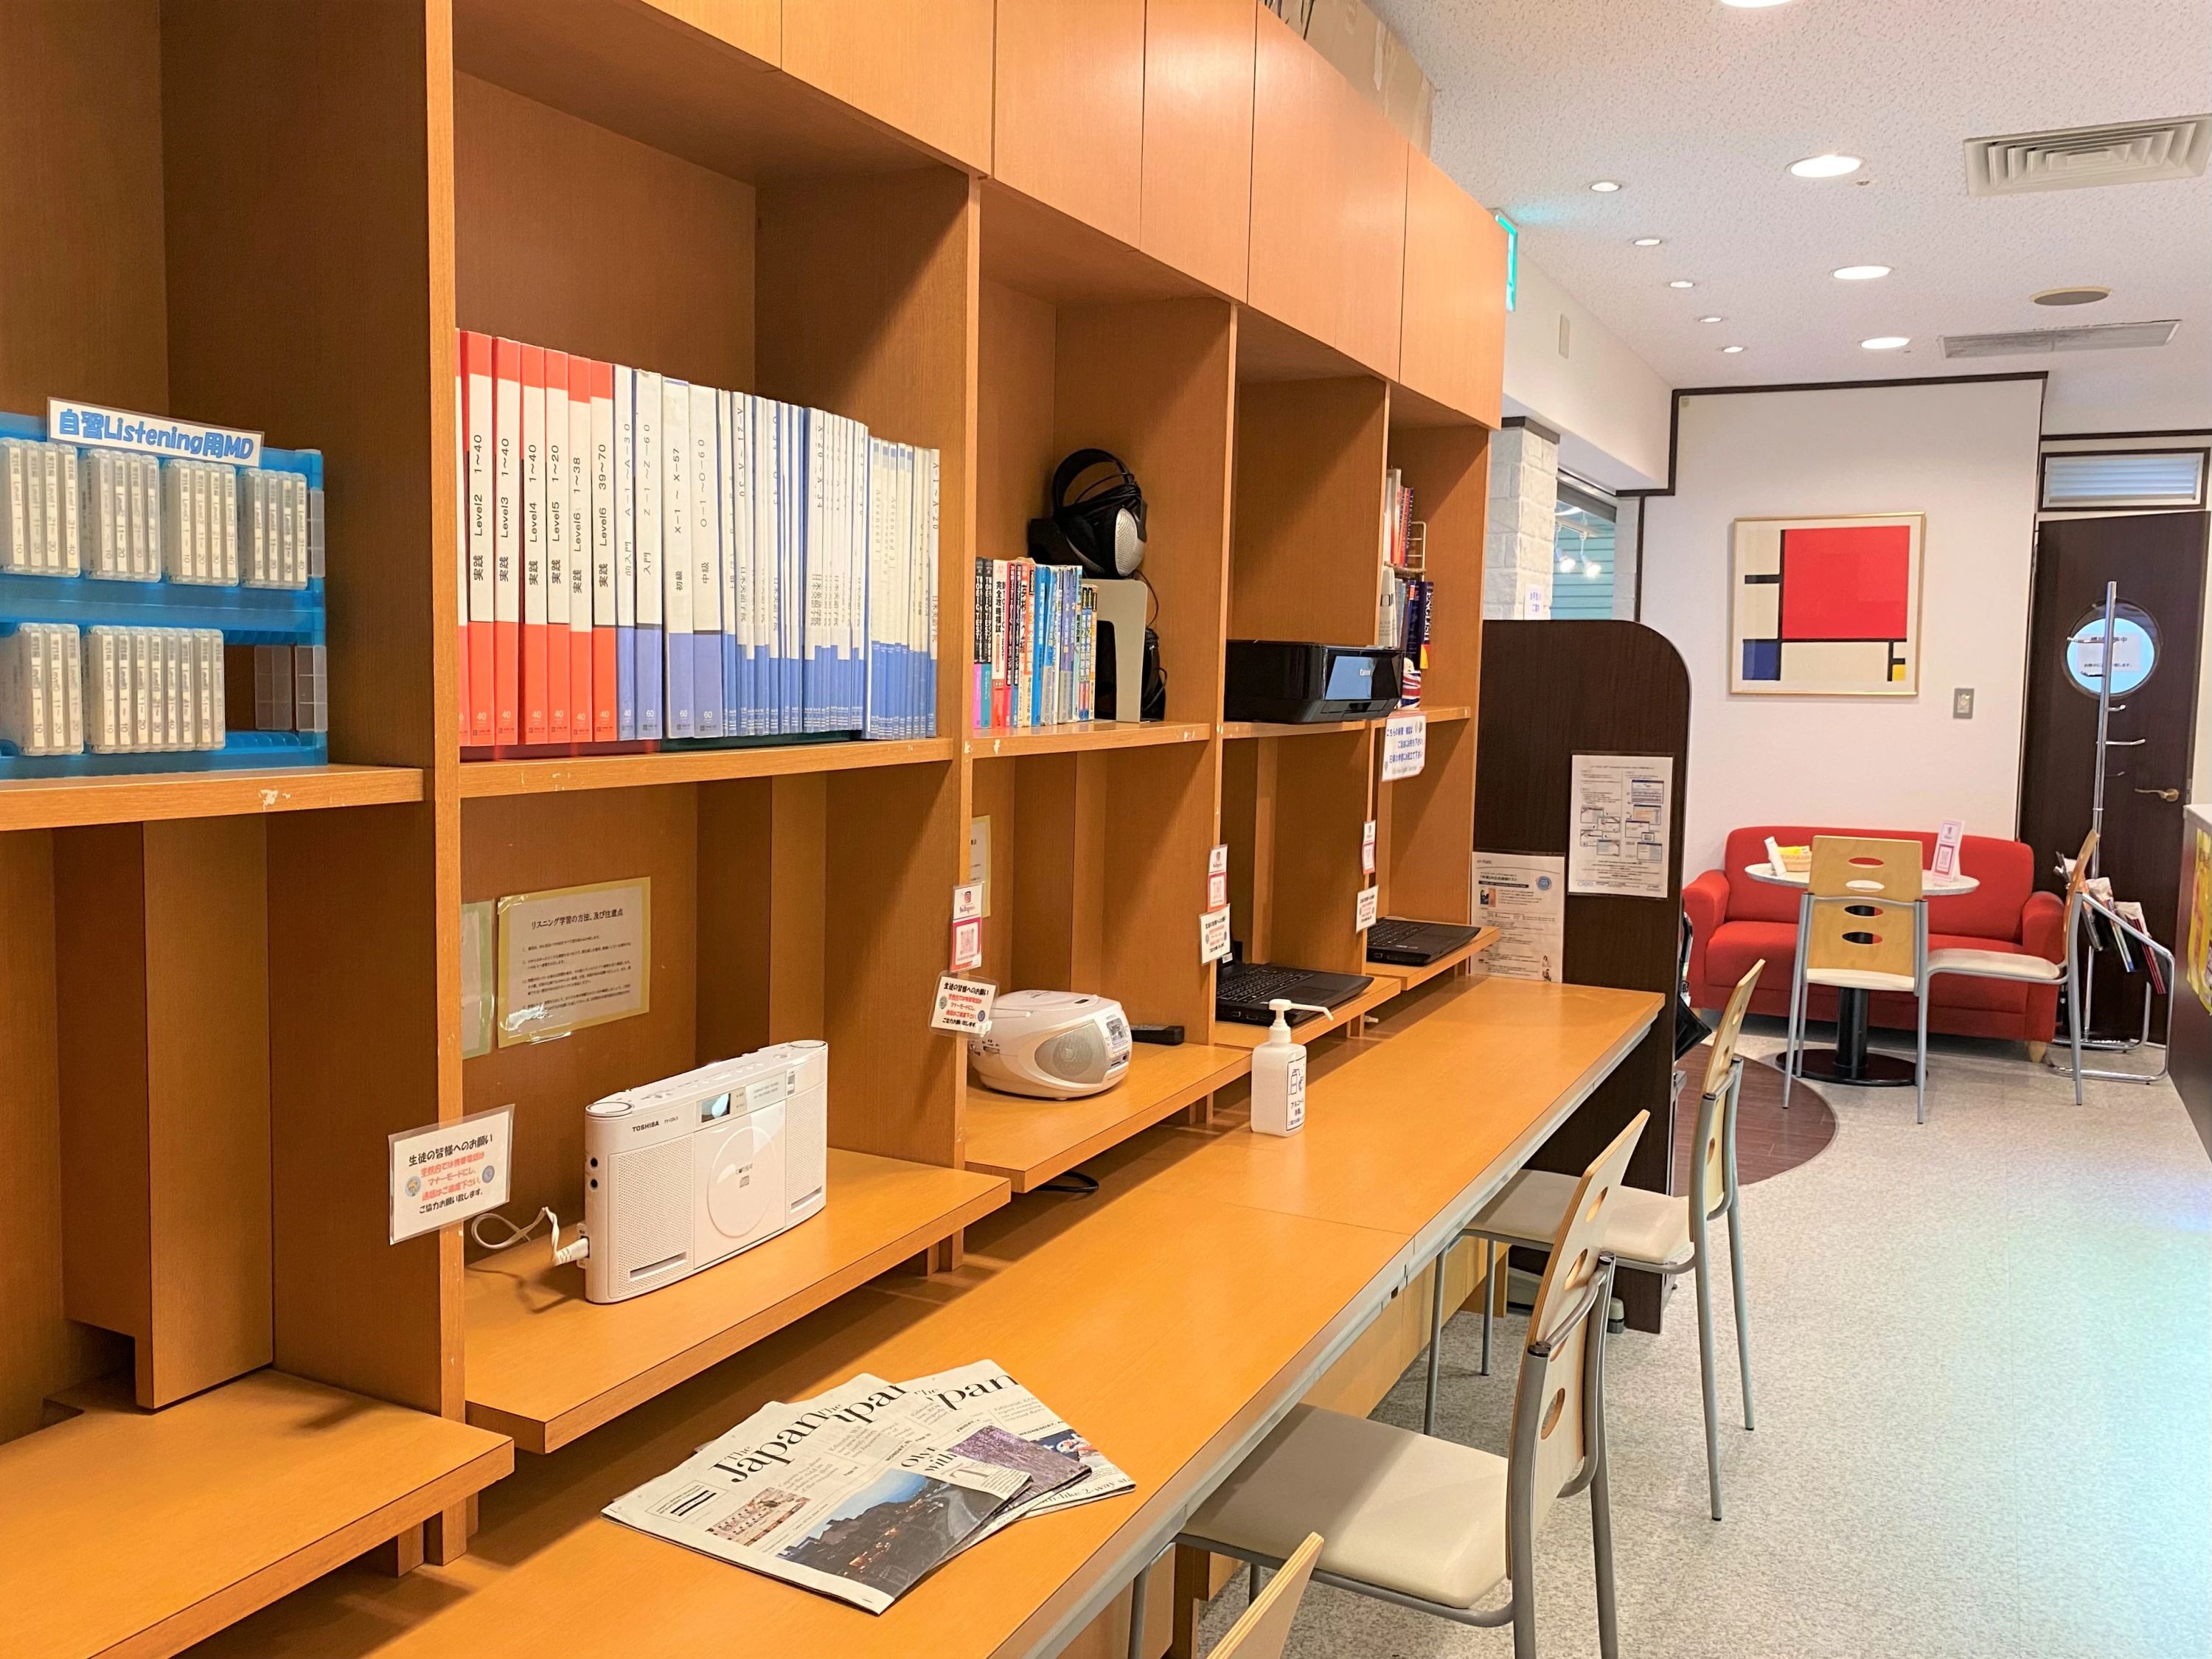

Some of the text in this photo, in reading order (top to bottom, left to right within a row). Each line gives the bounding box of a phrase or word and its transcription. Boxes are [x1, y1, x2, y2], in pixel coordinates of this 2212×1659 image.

[59, 408, 254, 459] 自習Listening用MD
[474, 494, 483, 537] Level2
[501, 497, 509, 538] Level3
[529, 502, 538, 543] Level4
[552, 501, 560, 542] Level5
[573, 512, 582, 552] Level6
[599, 507, 608, 546] Level6
[646, 709, 654, 717] 60
[703, 711, 712, 719] 60
[632, 1121, 659, 1133] TOSHIBA
[408, 1134, 493, 1166] 生徒の皆様へのお願い
[708, 1411, 831, 1483] Japan
[724, 1445, 753, 1462] The
